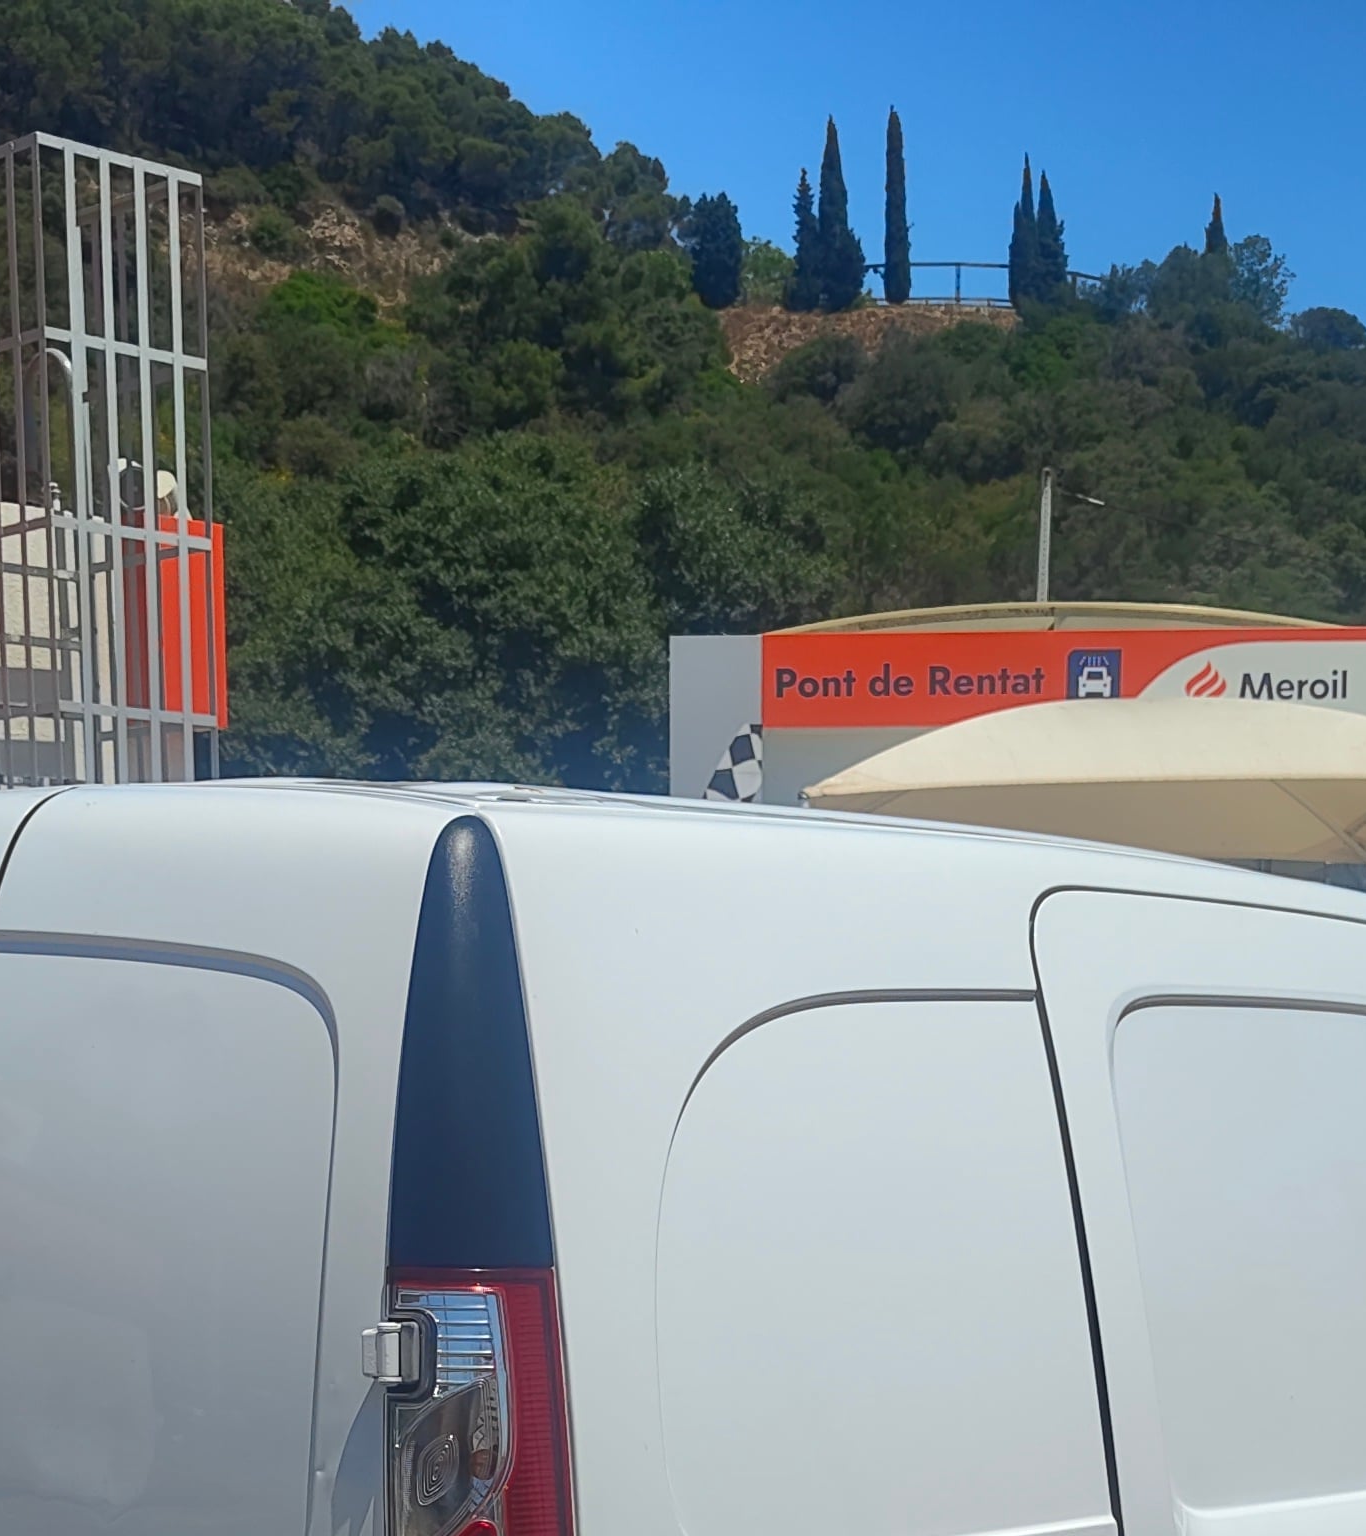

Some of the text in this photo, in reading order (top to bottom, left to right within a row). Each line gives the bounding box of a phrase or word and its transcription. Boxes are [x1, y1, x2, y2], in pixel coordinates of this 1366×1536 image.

[775, 663, 1045, 698] Pont de Rentat
[1239, 669, 1348, 700] Meroil
